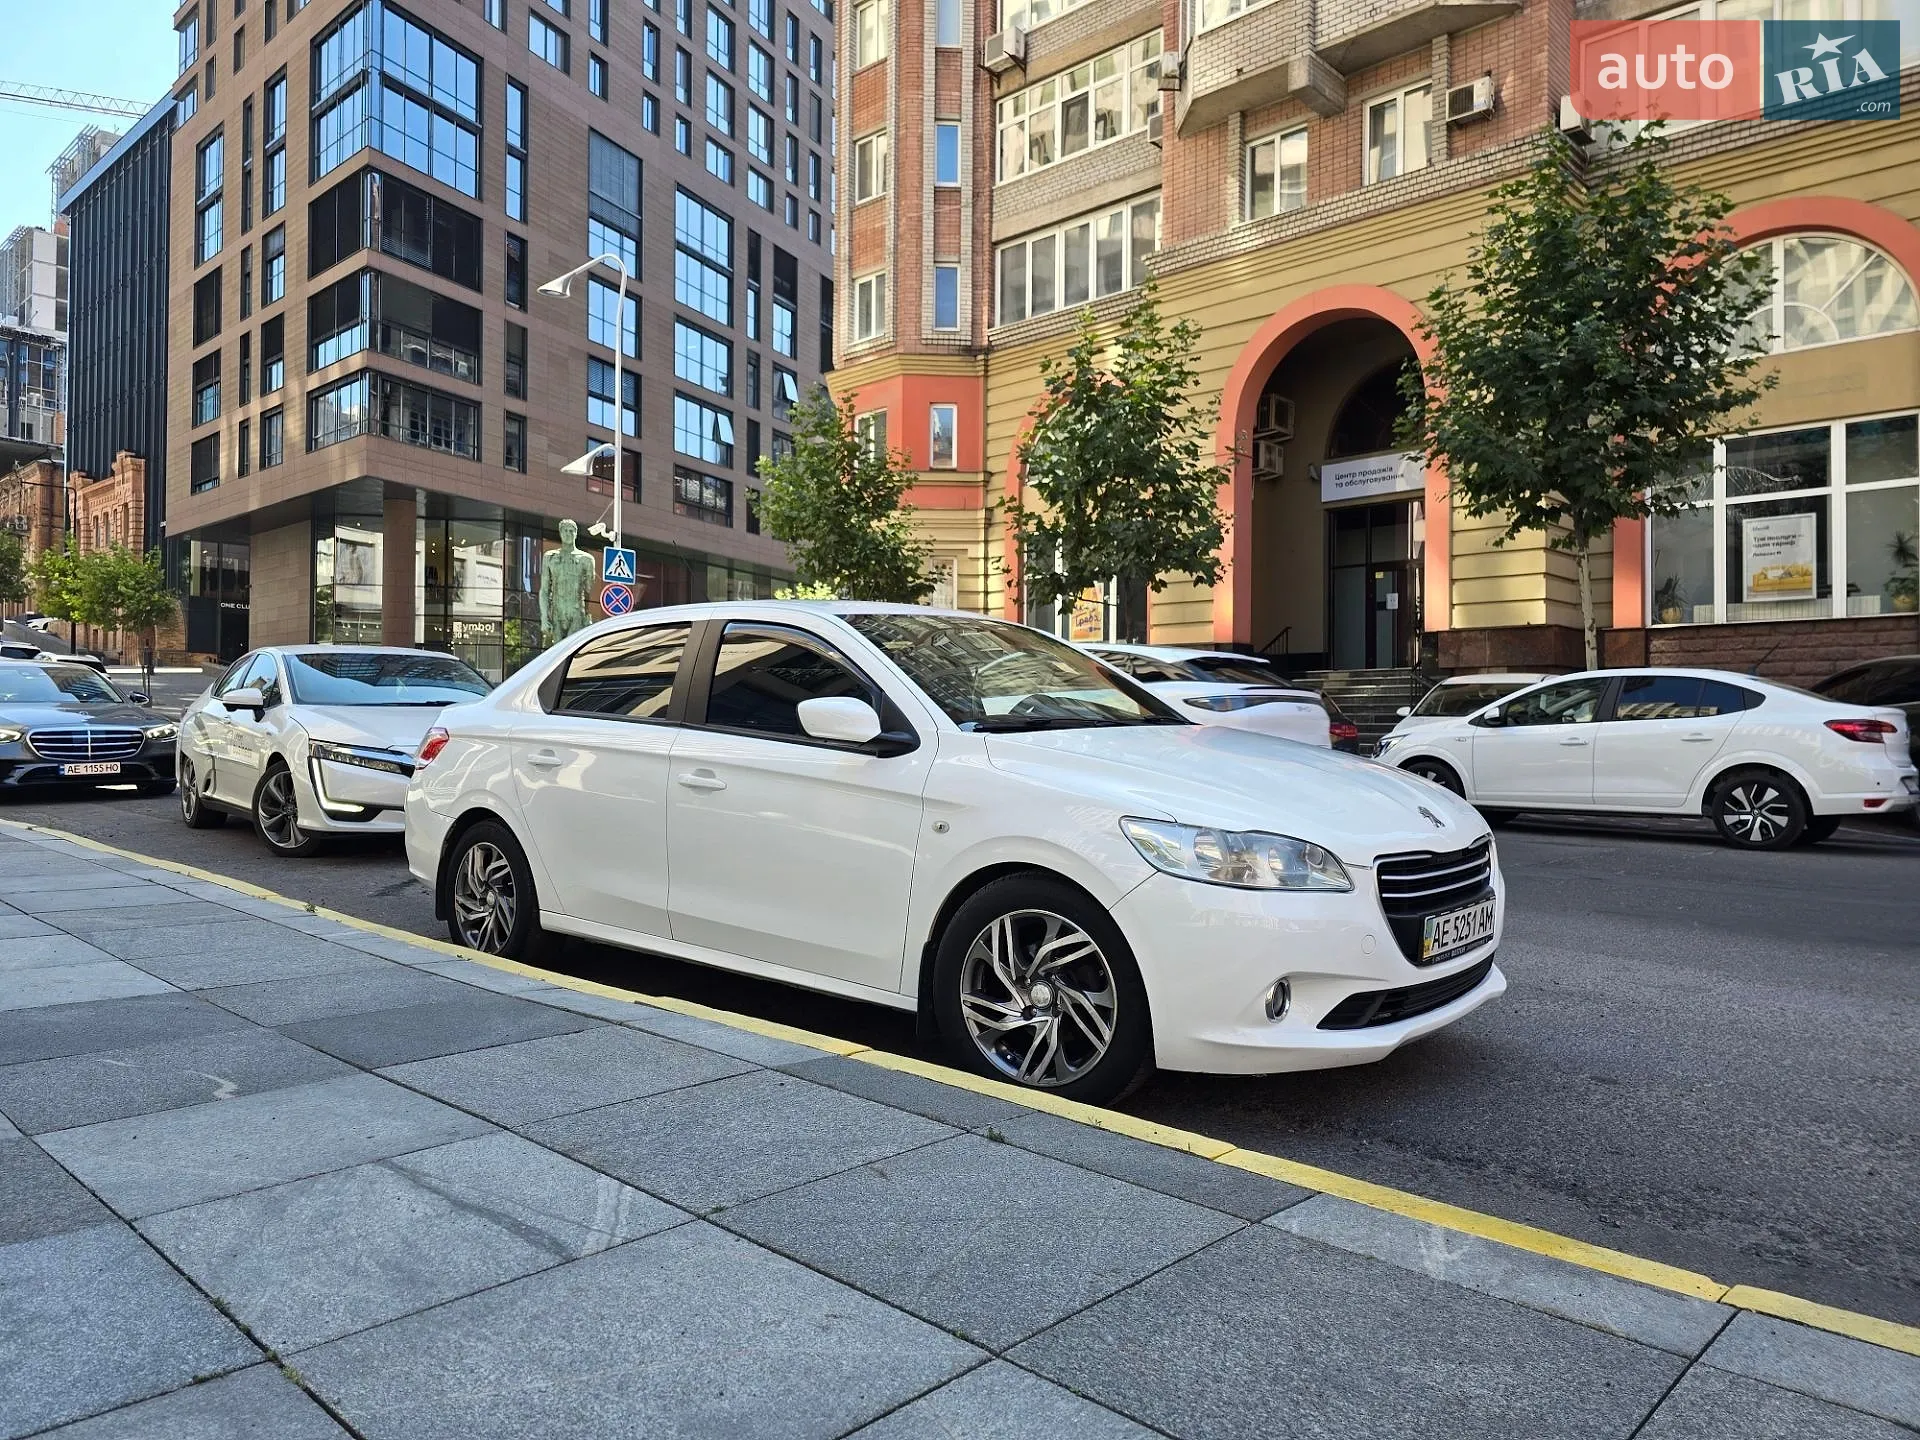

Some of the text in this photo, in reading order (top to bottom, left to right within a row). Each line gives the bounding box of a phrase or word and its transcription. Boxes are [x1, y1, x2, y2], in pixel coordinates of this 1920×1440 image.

[1335, 464, 1393, 481] Центр продажів
[67, 763, 119, 774] AE 1155 HO
[1432, 919, 1451, 951] AE
[1452, 909, 1478, 944] 5251
[1478, 903, 1494, 935] AM
